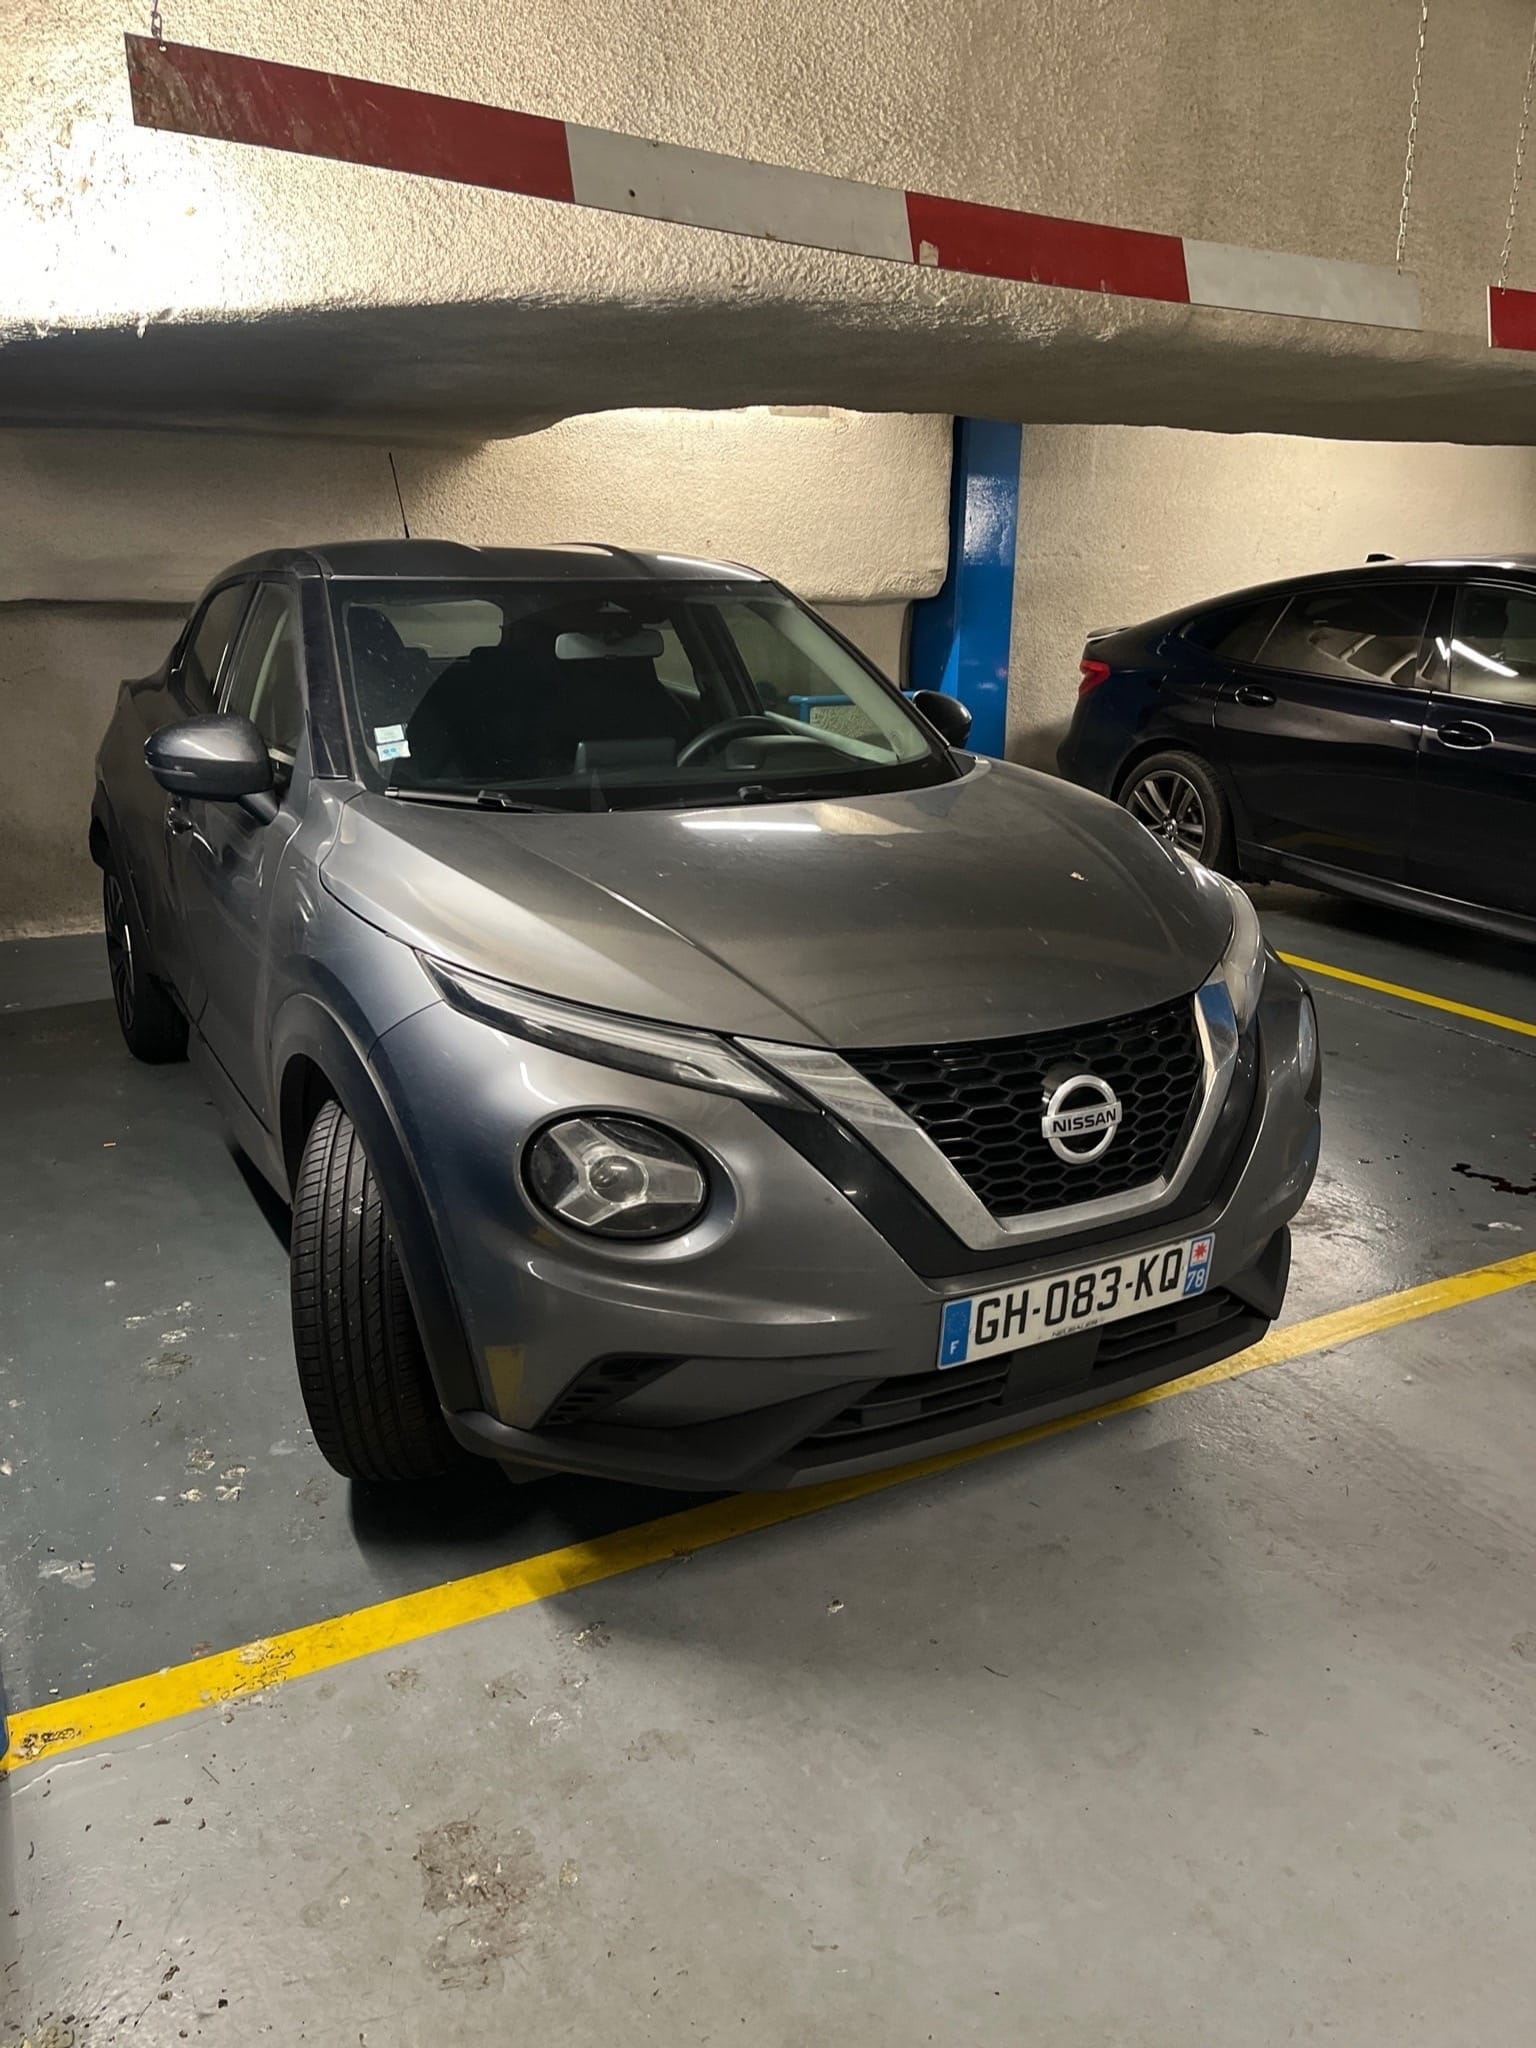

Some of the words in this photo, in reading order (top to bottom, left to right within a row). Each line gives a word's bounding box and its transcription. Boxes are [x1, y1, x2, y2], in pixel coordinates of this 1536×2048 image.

[1053, 1108, 1116, 1132] NISSAN
[1187, 1268, 1205, 1290] 78
[975, 1248, 1183, 1345] GH-083-KQ
[949, 1340, 960, 1356] F
